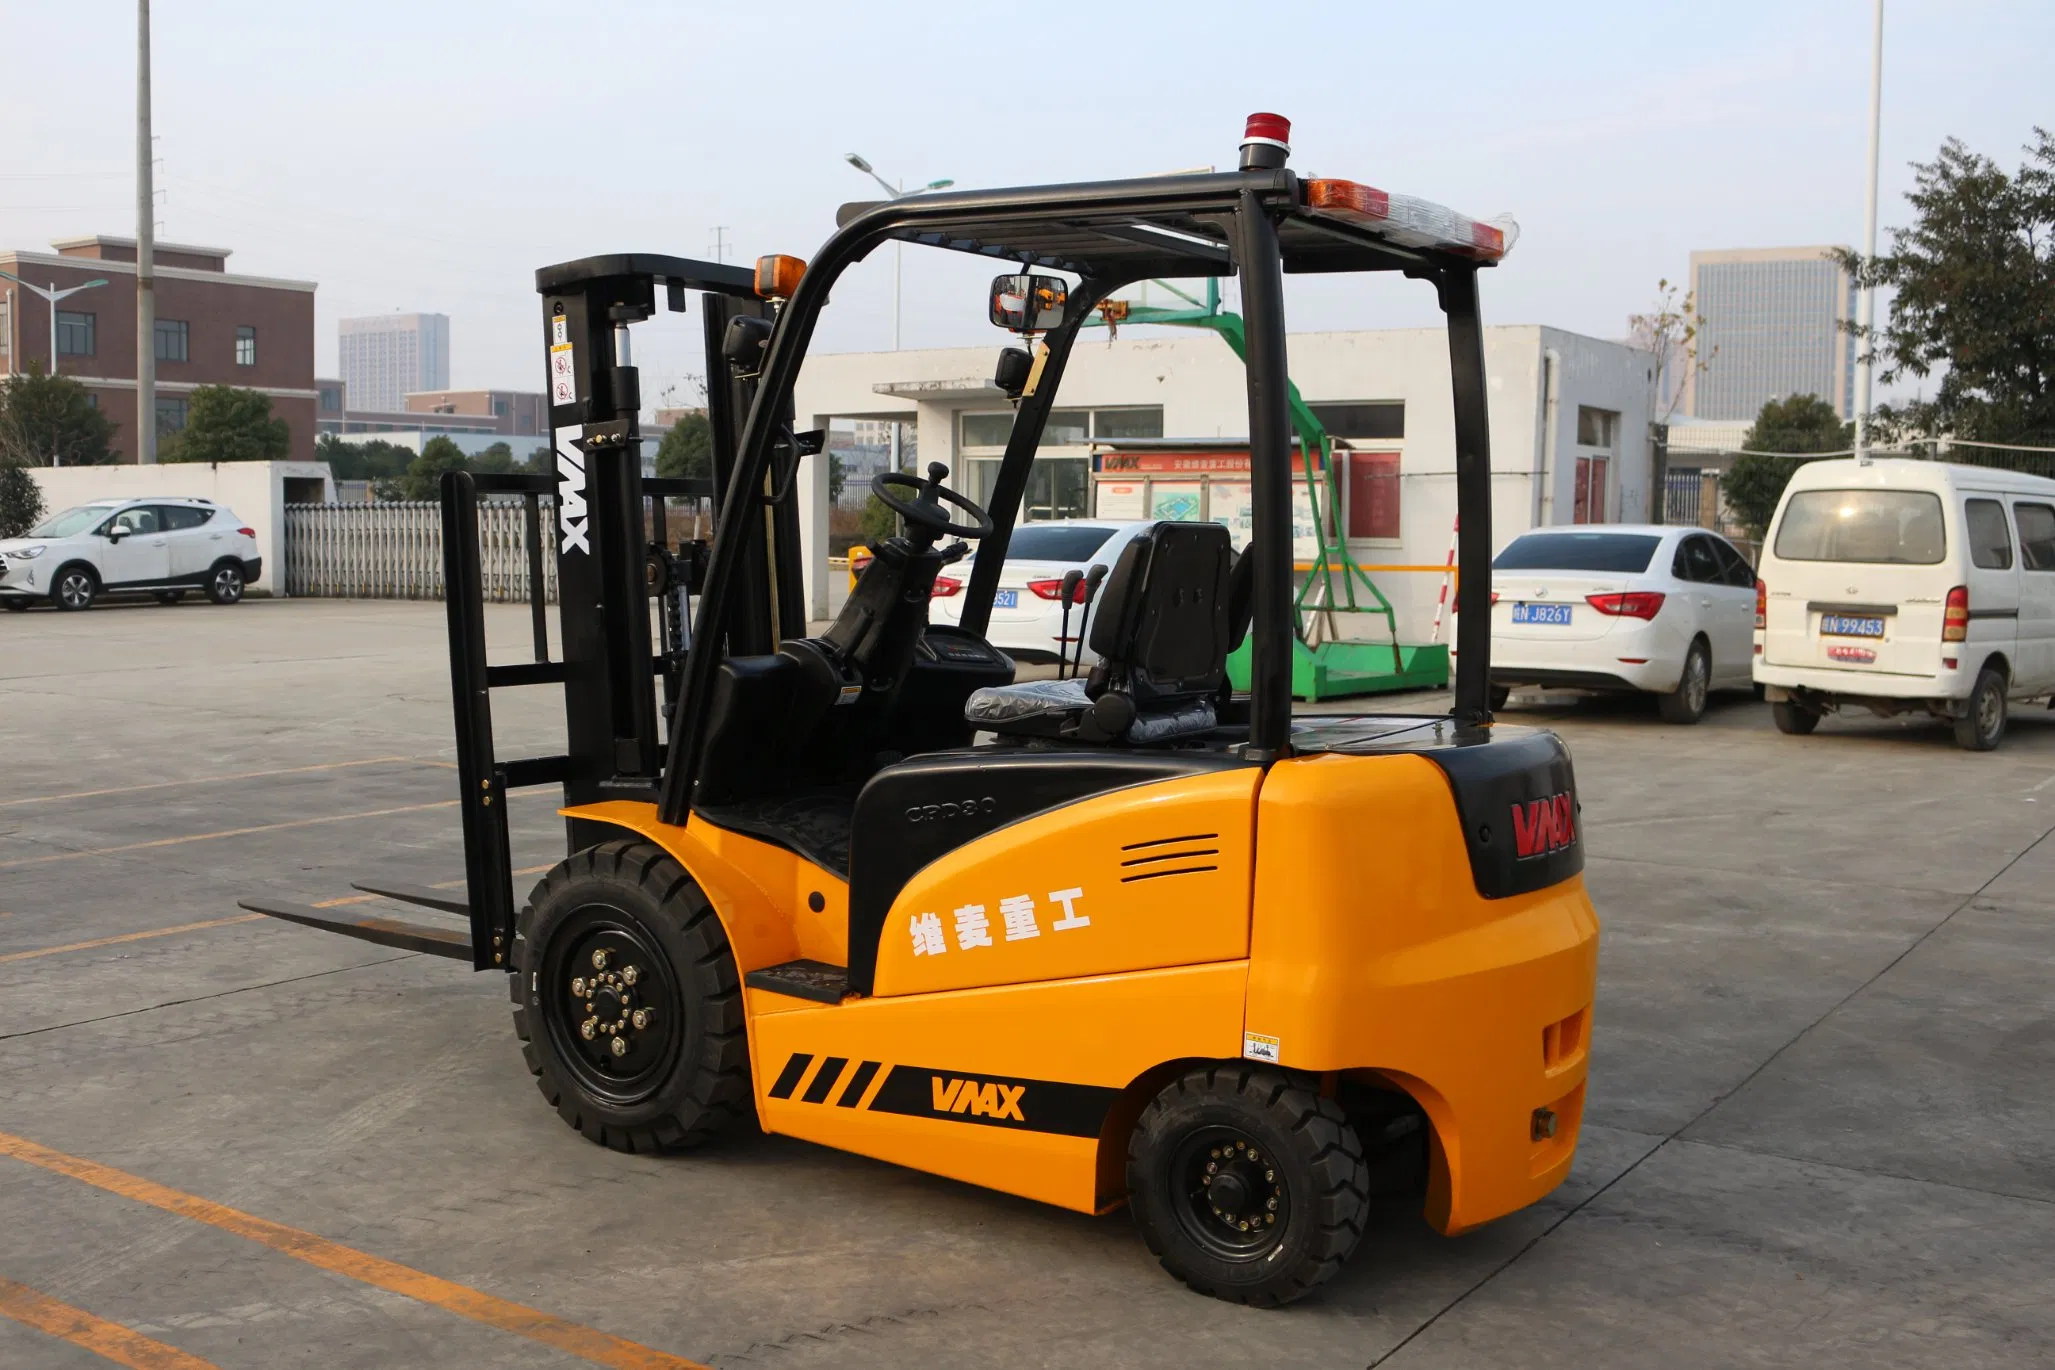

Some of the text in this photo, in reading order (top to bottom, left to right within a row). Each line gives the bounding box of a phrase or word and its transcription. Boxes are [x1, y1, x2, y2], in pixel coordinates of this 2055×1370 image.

[555, 424, 590, 555] VMAX
[1105, 456, 1139, 469] VMAX
[1842, 619, 1882, 635] 99453
[1511, 791, 1577, 860] VMAX
[909, 887, 1090, 957] 维麦重工
[931, 1076, 1026, 1122] VMAX
